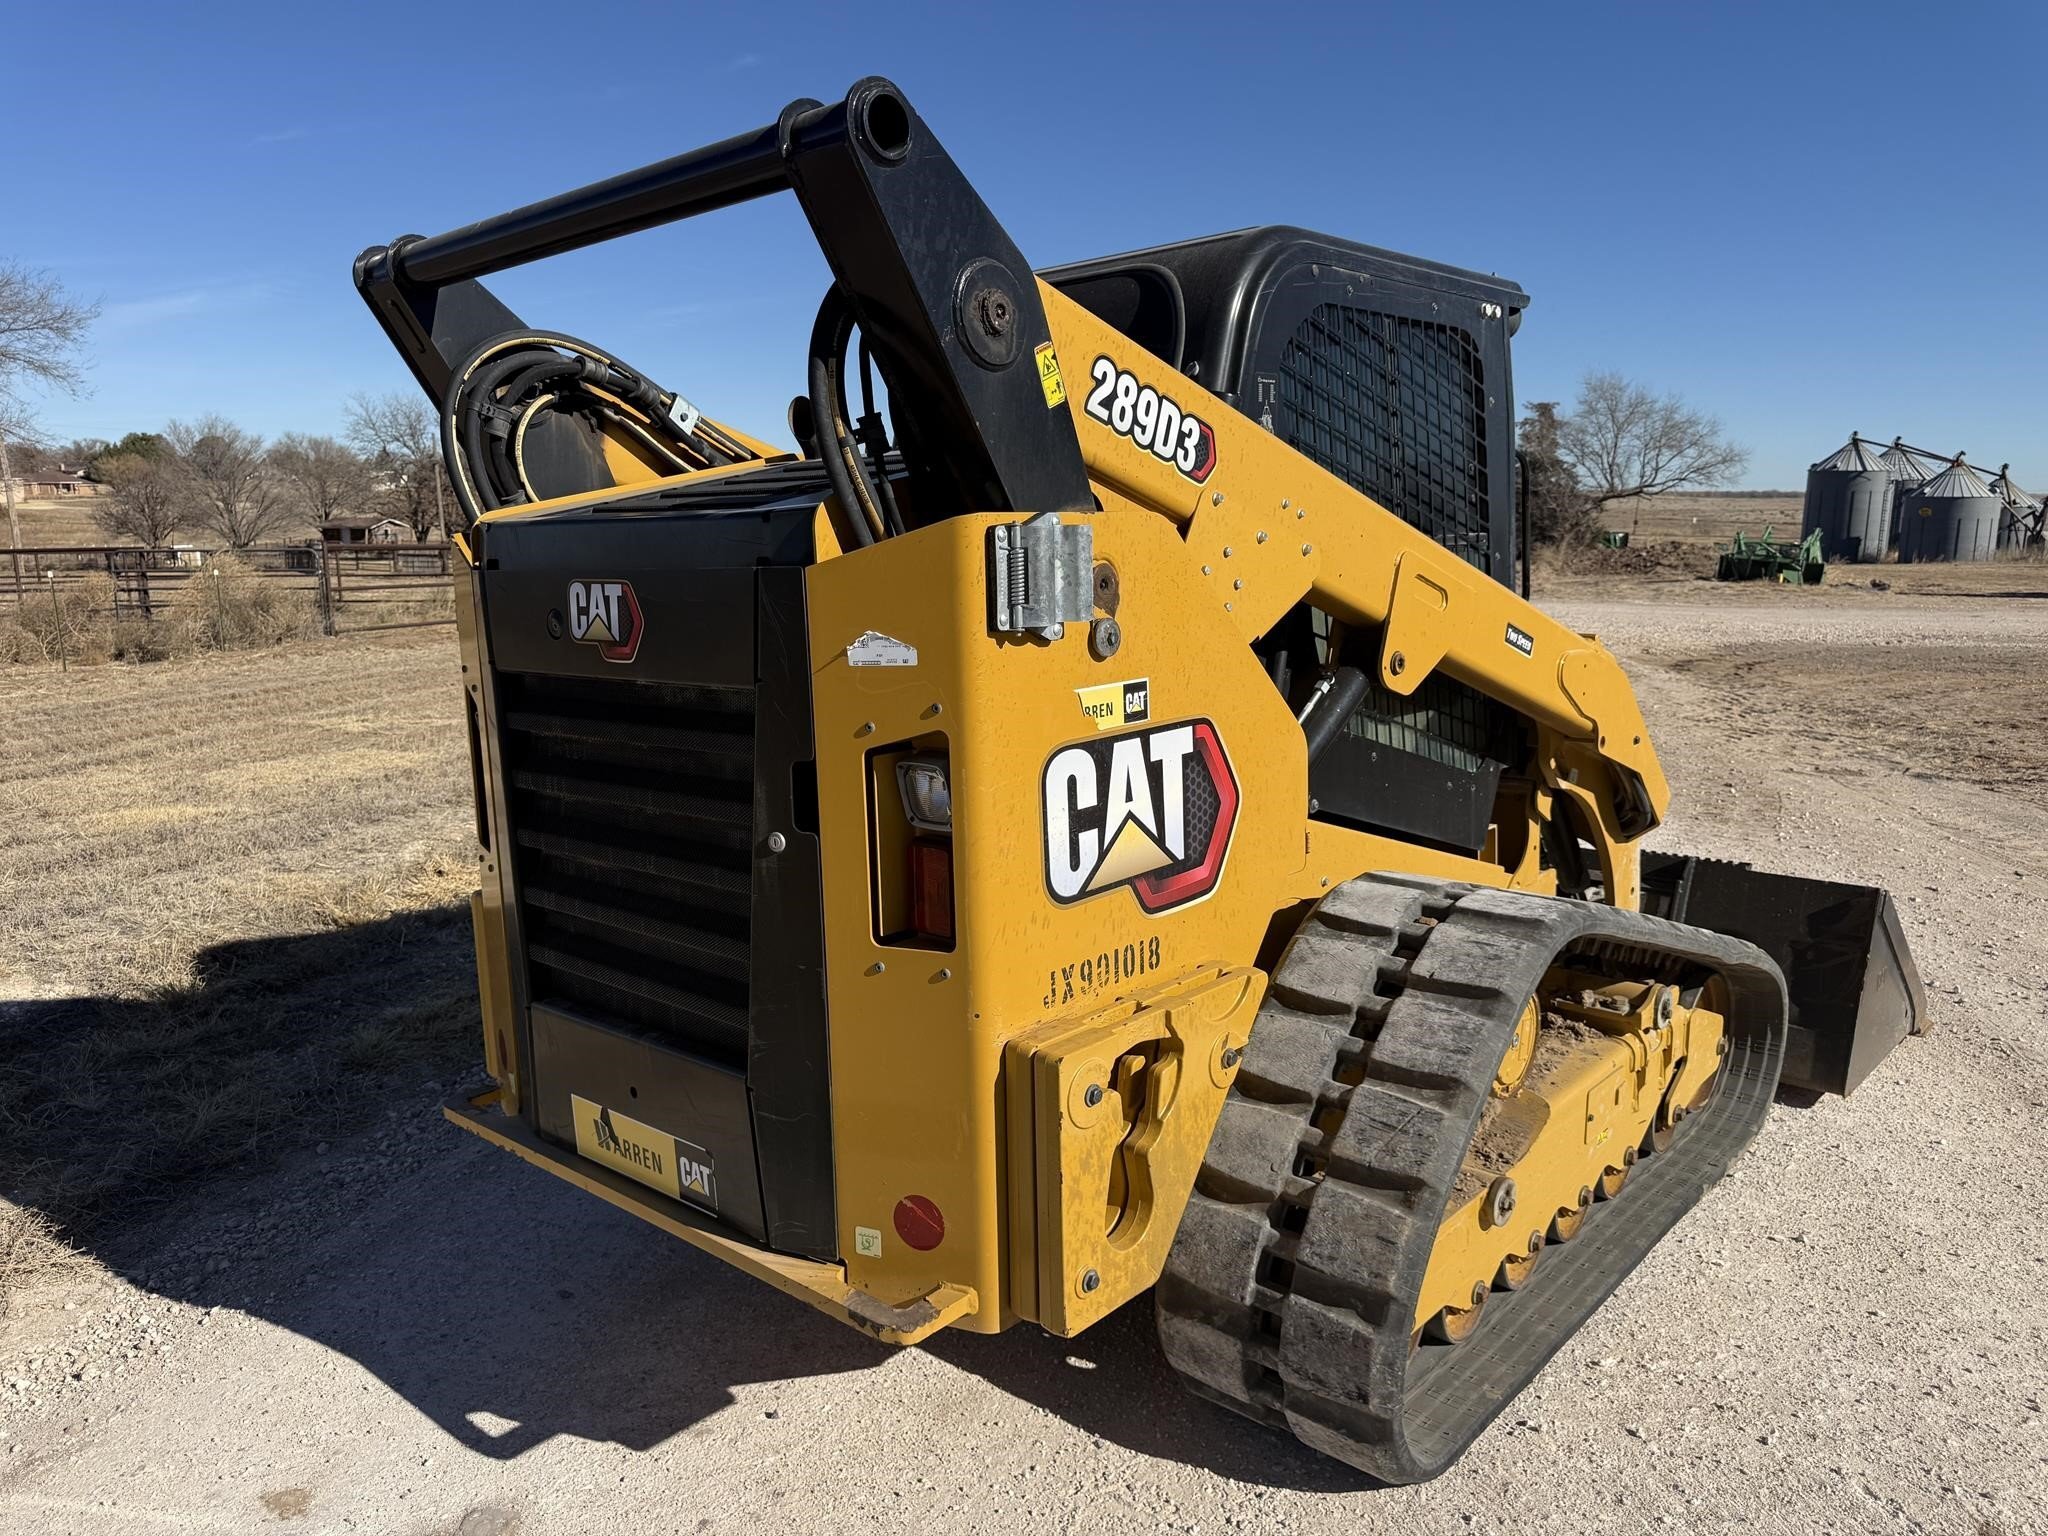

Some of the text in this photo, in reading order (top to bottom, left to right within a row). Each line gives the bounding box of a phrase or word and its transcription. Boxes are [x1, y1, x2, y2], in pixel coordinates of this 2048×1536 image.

[1086, 357, 1201, 473] 289D3
[569, 581, 622, 641] CAT
[1125, 690, 1147, 714] CAT
[1045, 725, 1194, 898] CAT
[1043, 935, 1161, 1009] JX901018
[679, 1156, 712, 1197] CAT
